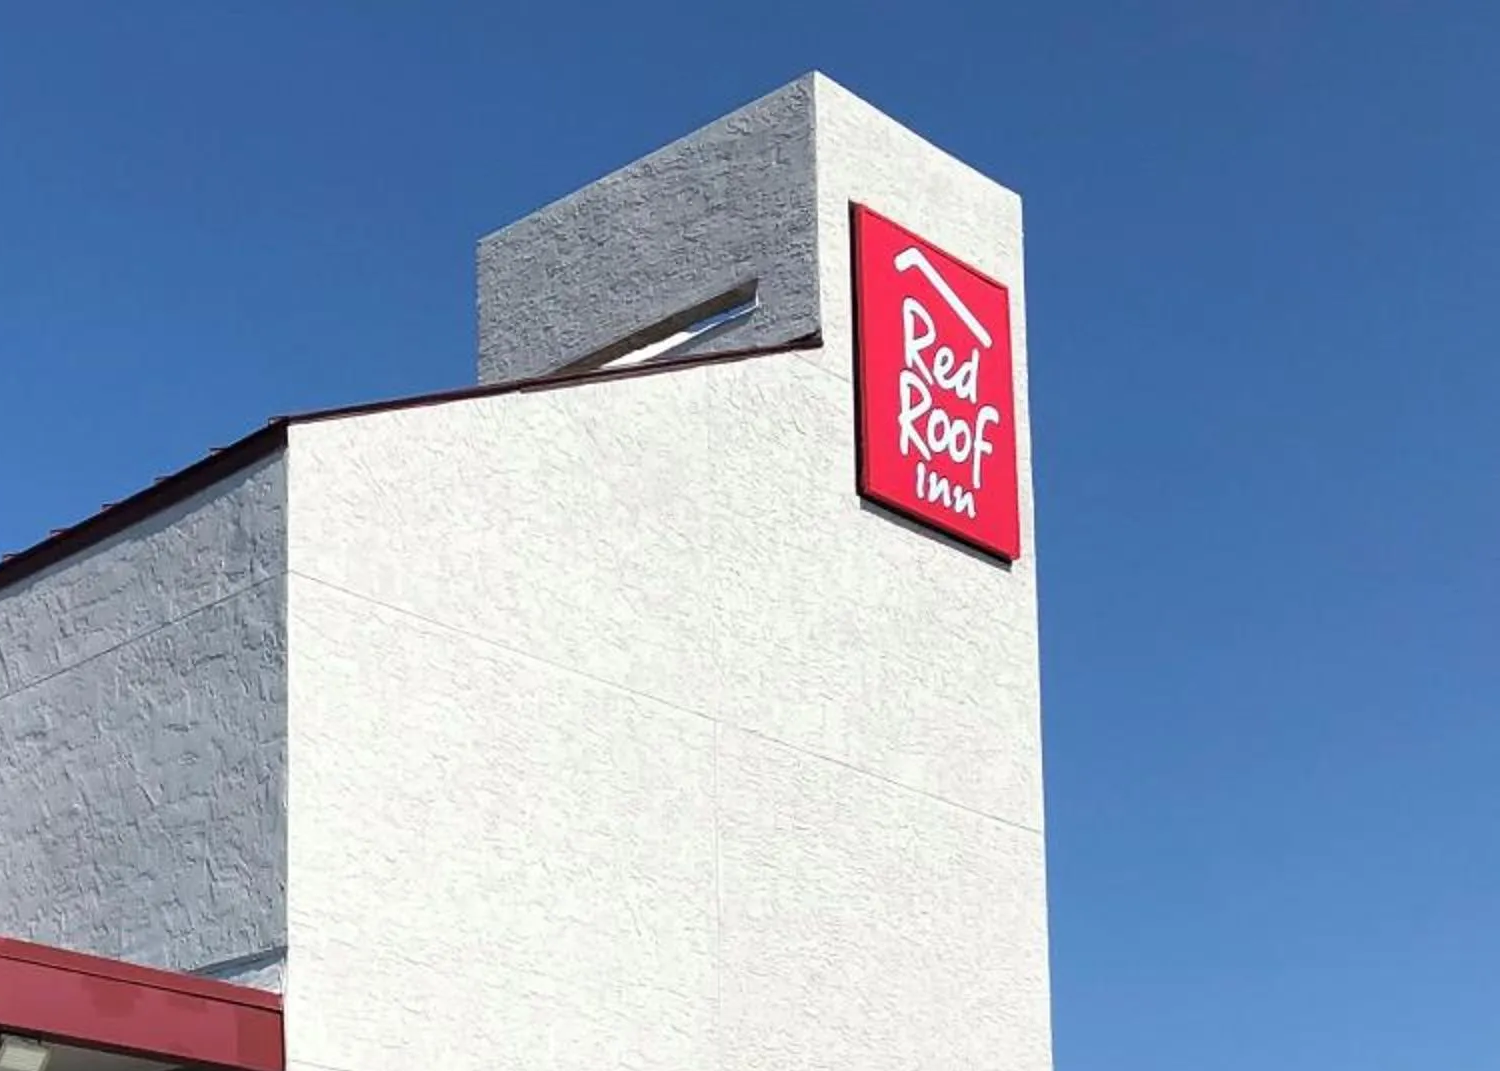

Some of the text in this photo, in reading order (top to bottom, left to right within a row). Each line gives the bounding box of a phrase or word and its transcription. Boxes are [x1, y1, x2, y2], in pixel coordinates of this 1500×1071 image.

[903, 298, 979, 403] Red
[898, 370, 1000, 489] Roof
[916, 462, 977, 518] Inn
